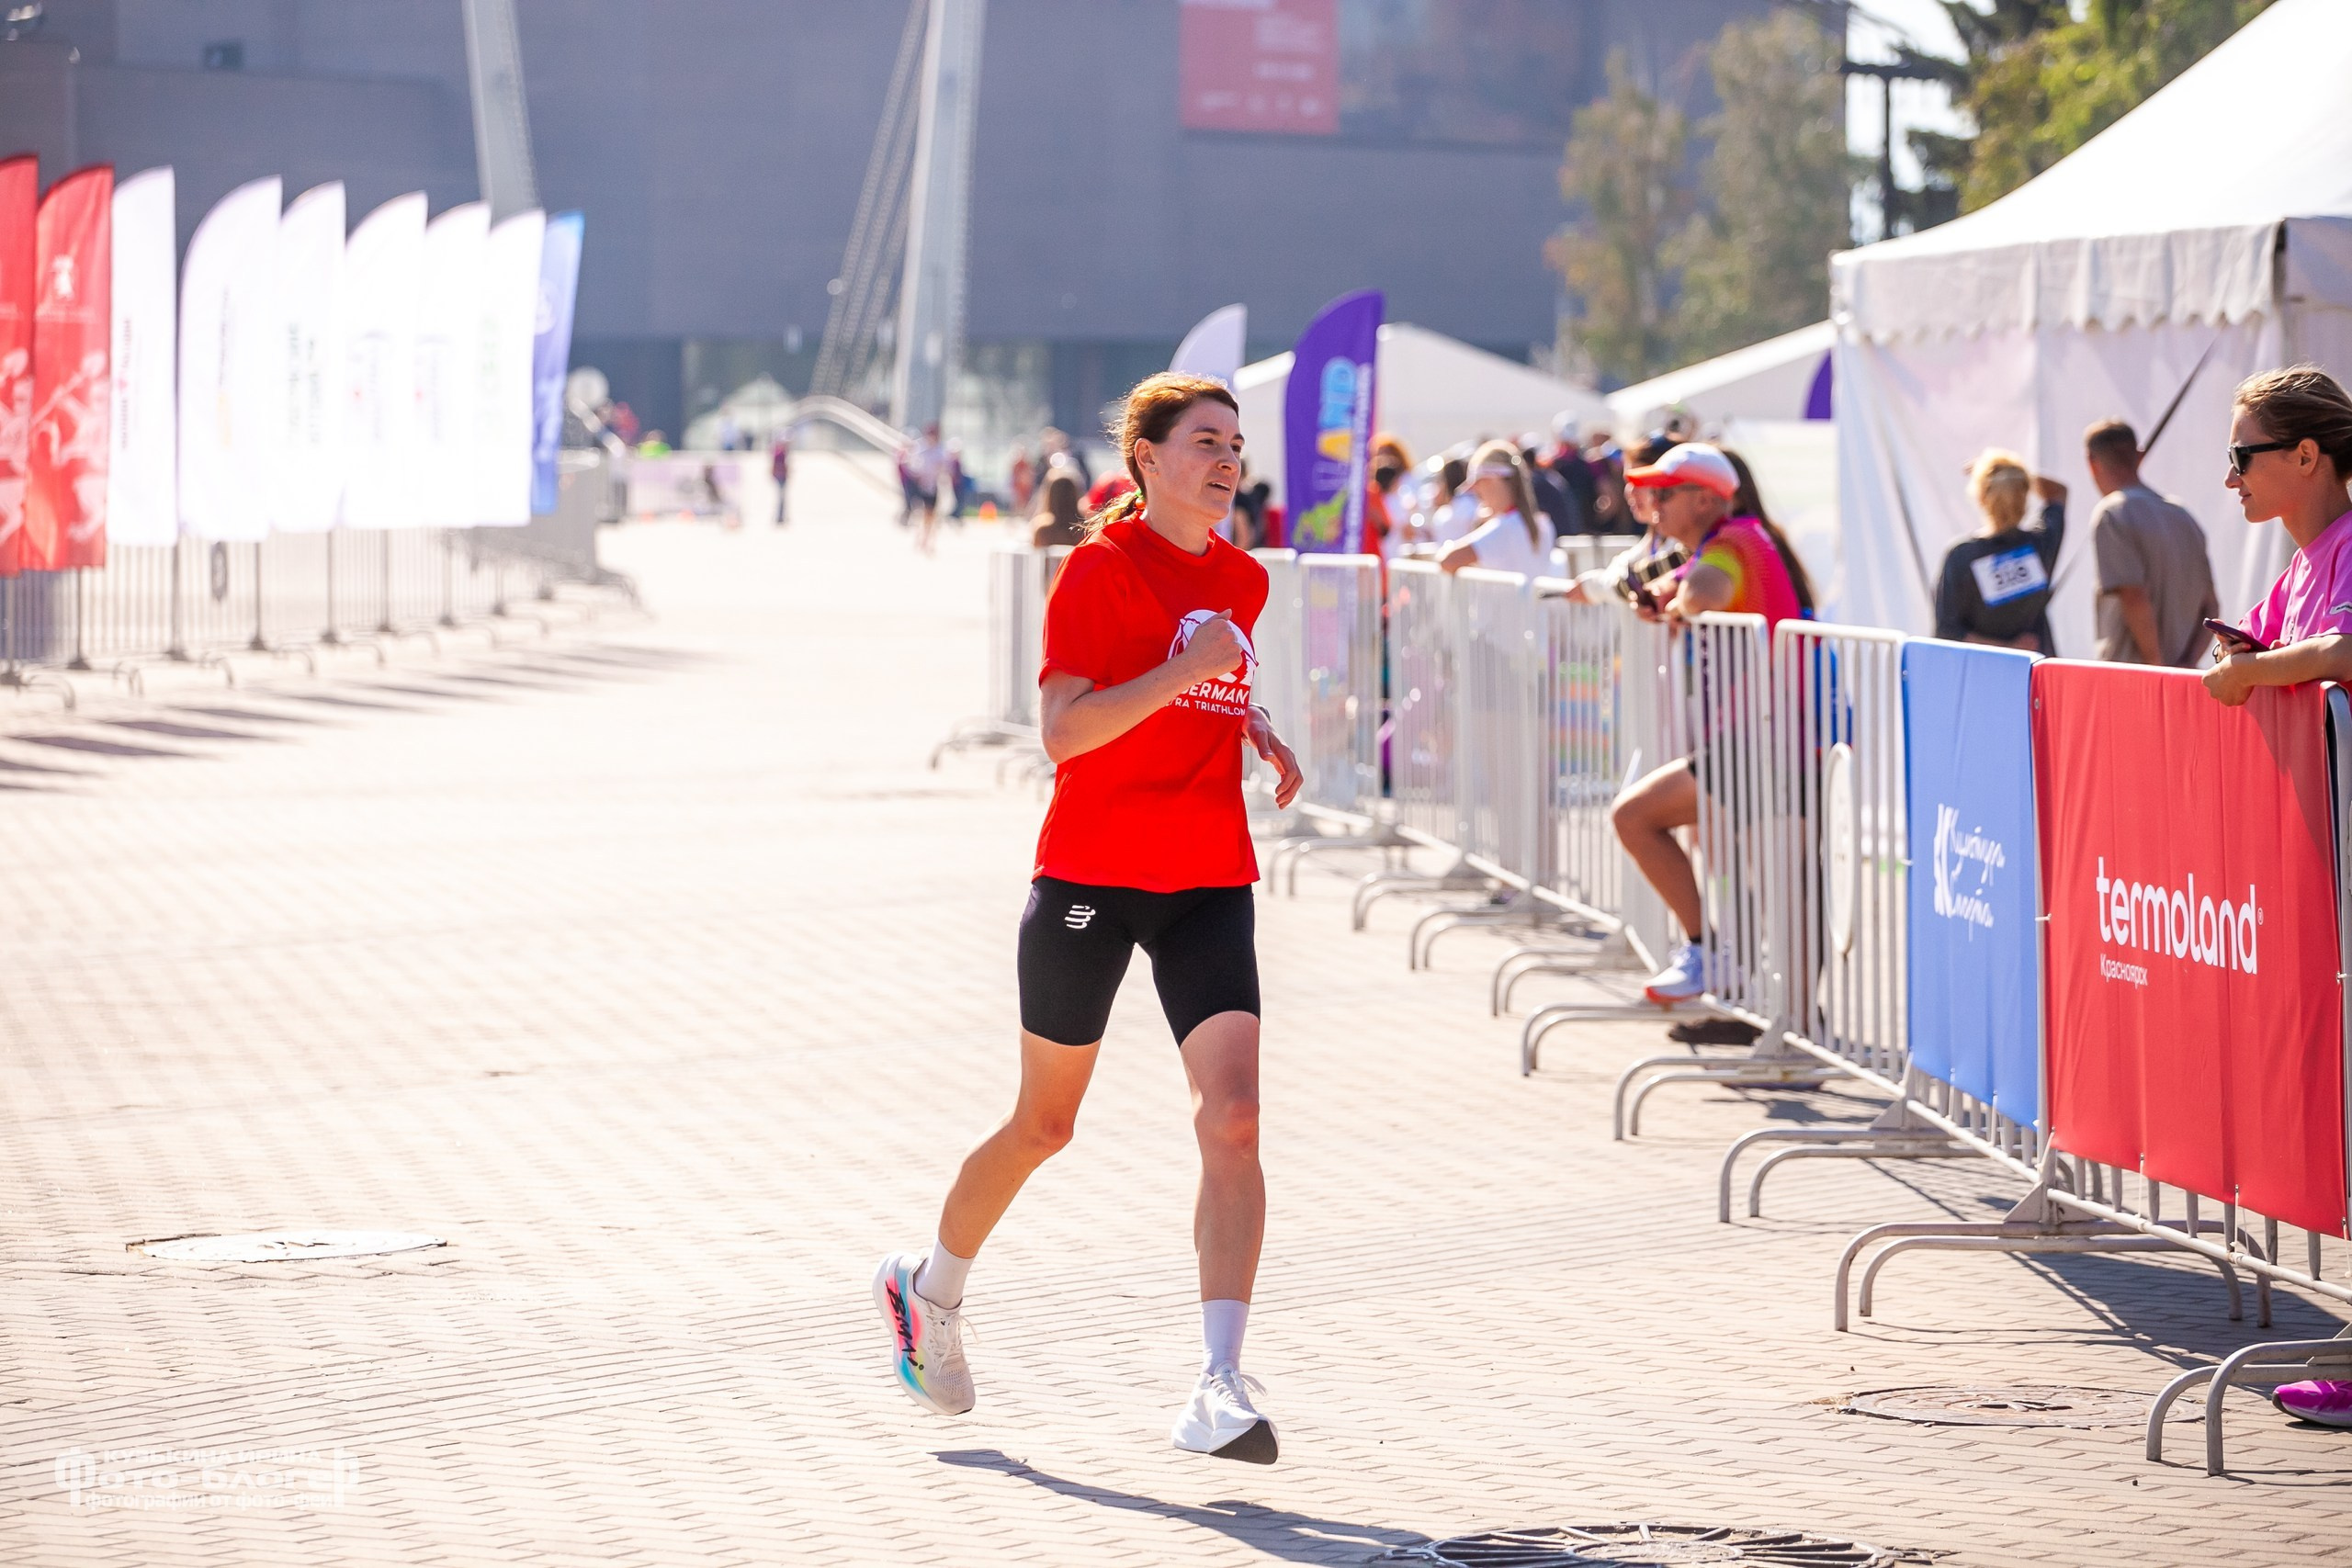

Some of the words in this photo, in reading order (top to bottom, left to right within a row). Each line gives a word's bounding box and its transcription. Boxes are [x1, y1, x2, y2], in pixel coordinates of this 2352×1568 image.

[1194, 700, 1246, 716] TRIATHLON
[2096, 856, 2257, 975] termoland
[2100, 953, 2149, 989] Красноярск
